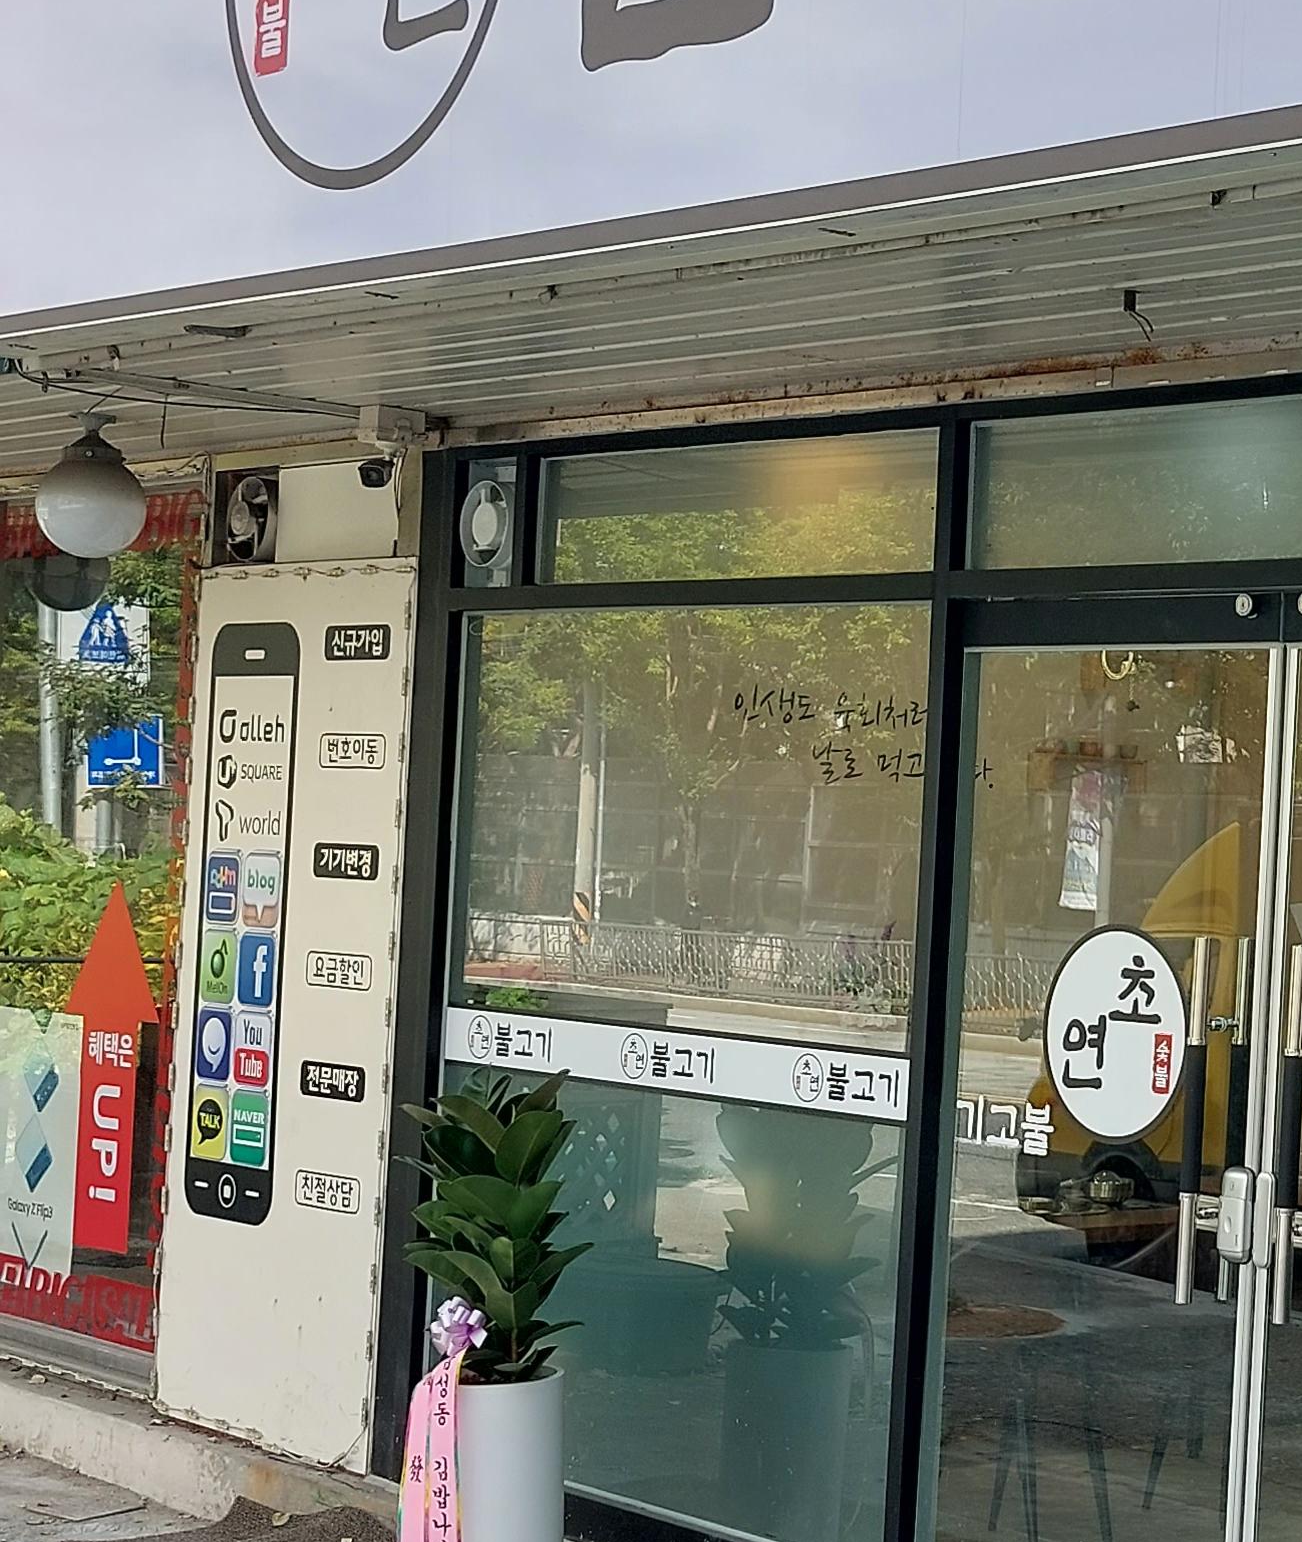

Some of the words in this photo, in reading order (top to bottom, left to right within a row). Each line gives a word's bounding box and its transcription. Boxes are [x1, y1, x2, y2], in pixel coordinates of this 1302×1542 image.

[331, 629, 384, 657] 신규가입
[735, 684, 815, 724] 인생도
[327, 738, 379, 766] 번호이동
[812, 741, 864, 784] 날로
[240, 763, 283, 783] SQUARE
[239, 810, 281, 836] world
[319, 848, 373, 878] 기기변경
[247, 869, 276, 896] blog
[313, 957, 364, 986] 요금할인
[243, 1019, 263, 1046] You
[494, 1022, 552, 1063] 불고기
[88, 1030, 136, 1069] 혜택은
[650, 1041, 715, 1084] 불고기
[239, 1053, 263, 1080] Tube
[306, 1064, 360, 1099] 전문매장
[826, 1062, 900, 1108] 불고기
[200, 1110, 221, 1130] TALK
[233, 1109, 265, 1125] NAVER
[301, 1175, 354, 1209] 친절상담
[7, 1197, 31, 1218] Galaxy
